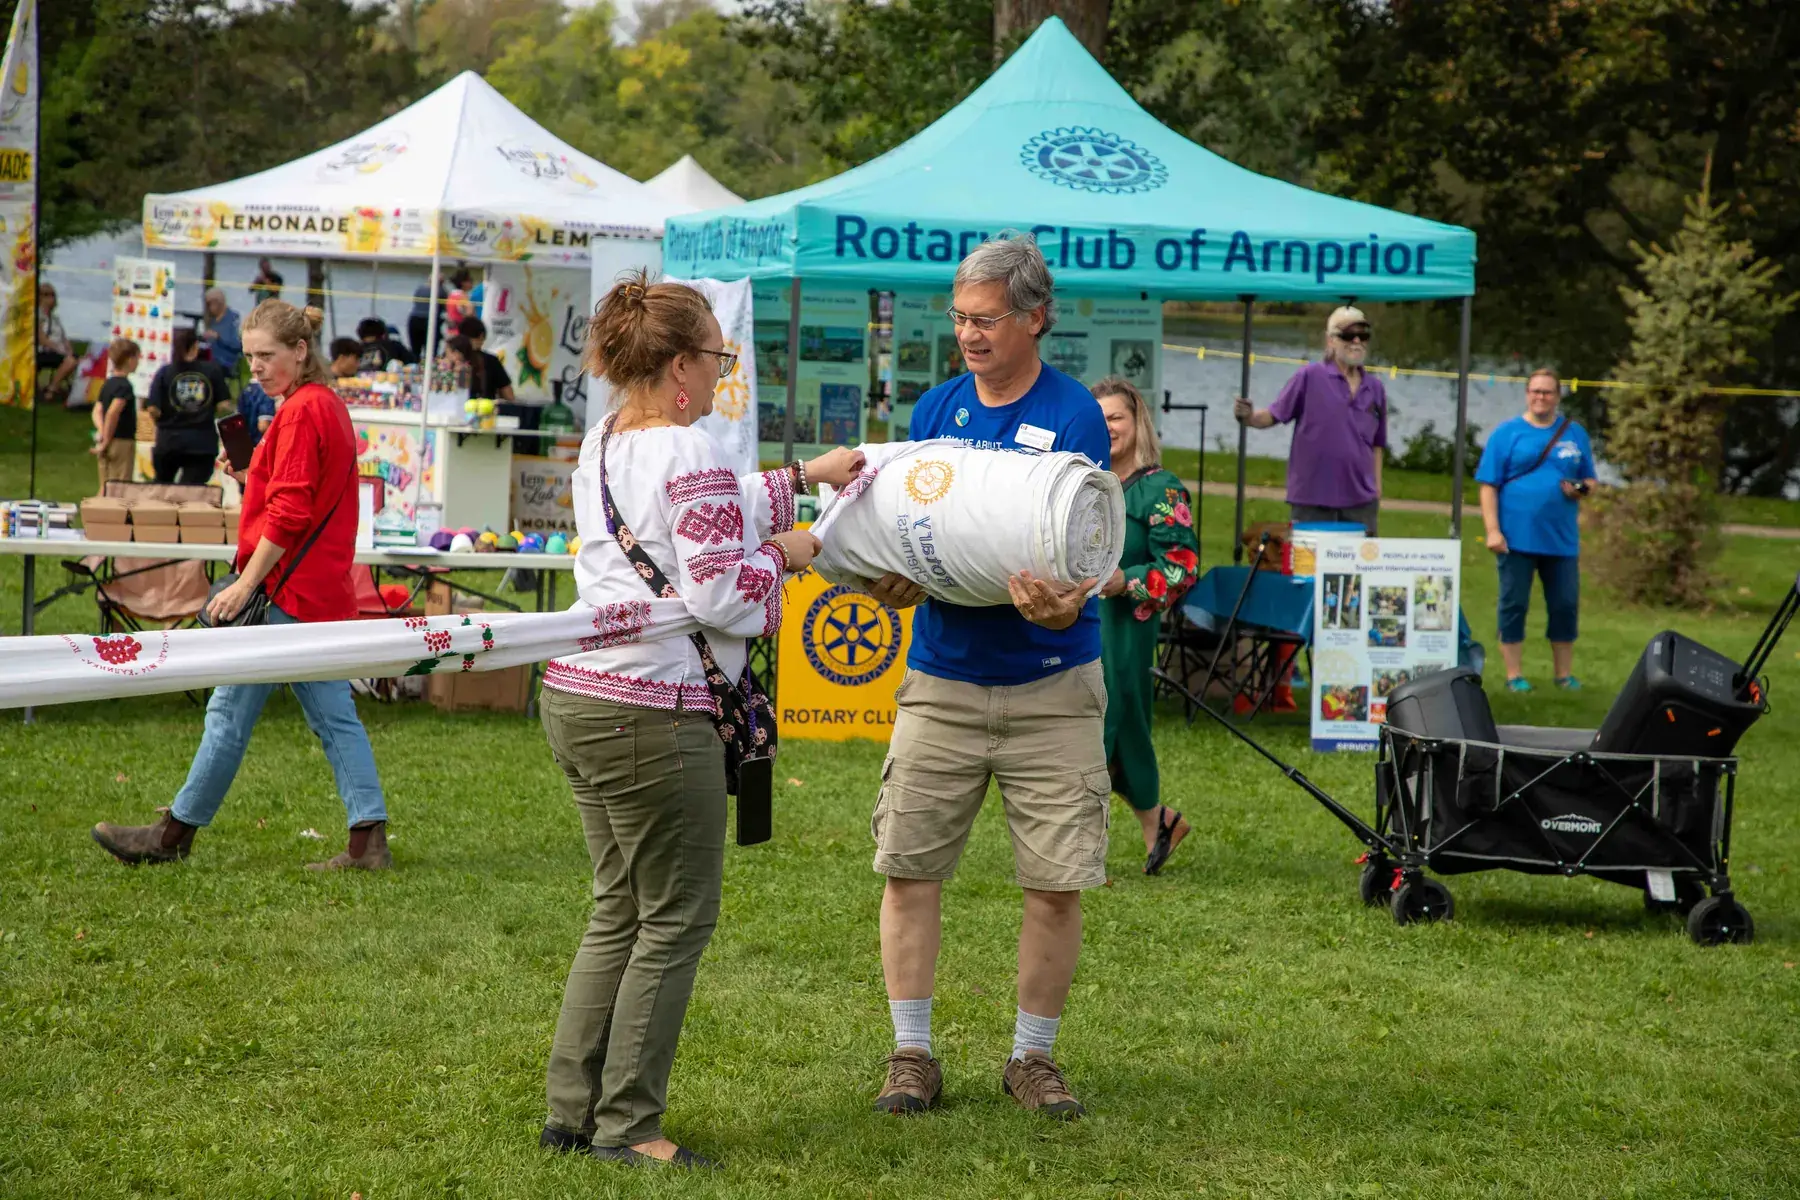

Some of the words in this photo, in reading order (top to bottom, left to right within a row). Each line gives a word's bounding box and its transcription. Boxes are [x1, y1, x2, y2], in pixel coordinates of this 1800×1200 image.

[0, 153, 28, 179] ADE
[220, 213, 350, 232] LEMONADE
[1155, 228, 1207, 272] of
[1223, 230, 1434, 284] Arnprior
[1326, 551, 1356, 560] Rotary
[783, 709, 858, 724] ROTARY
[863, 709, 897, 724] CLU
[1541, 818, 1602, 834] OVERMONT
